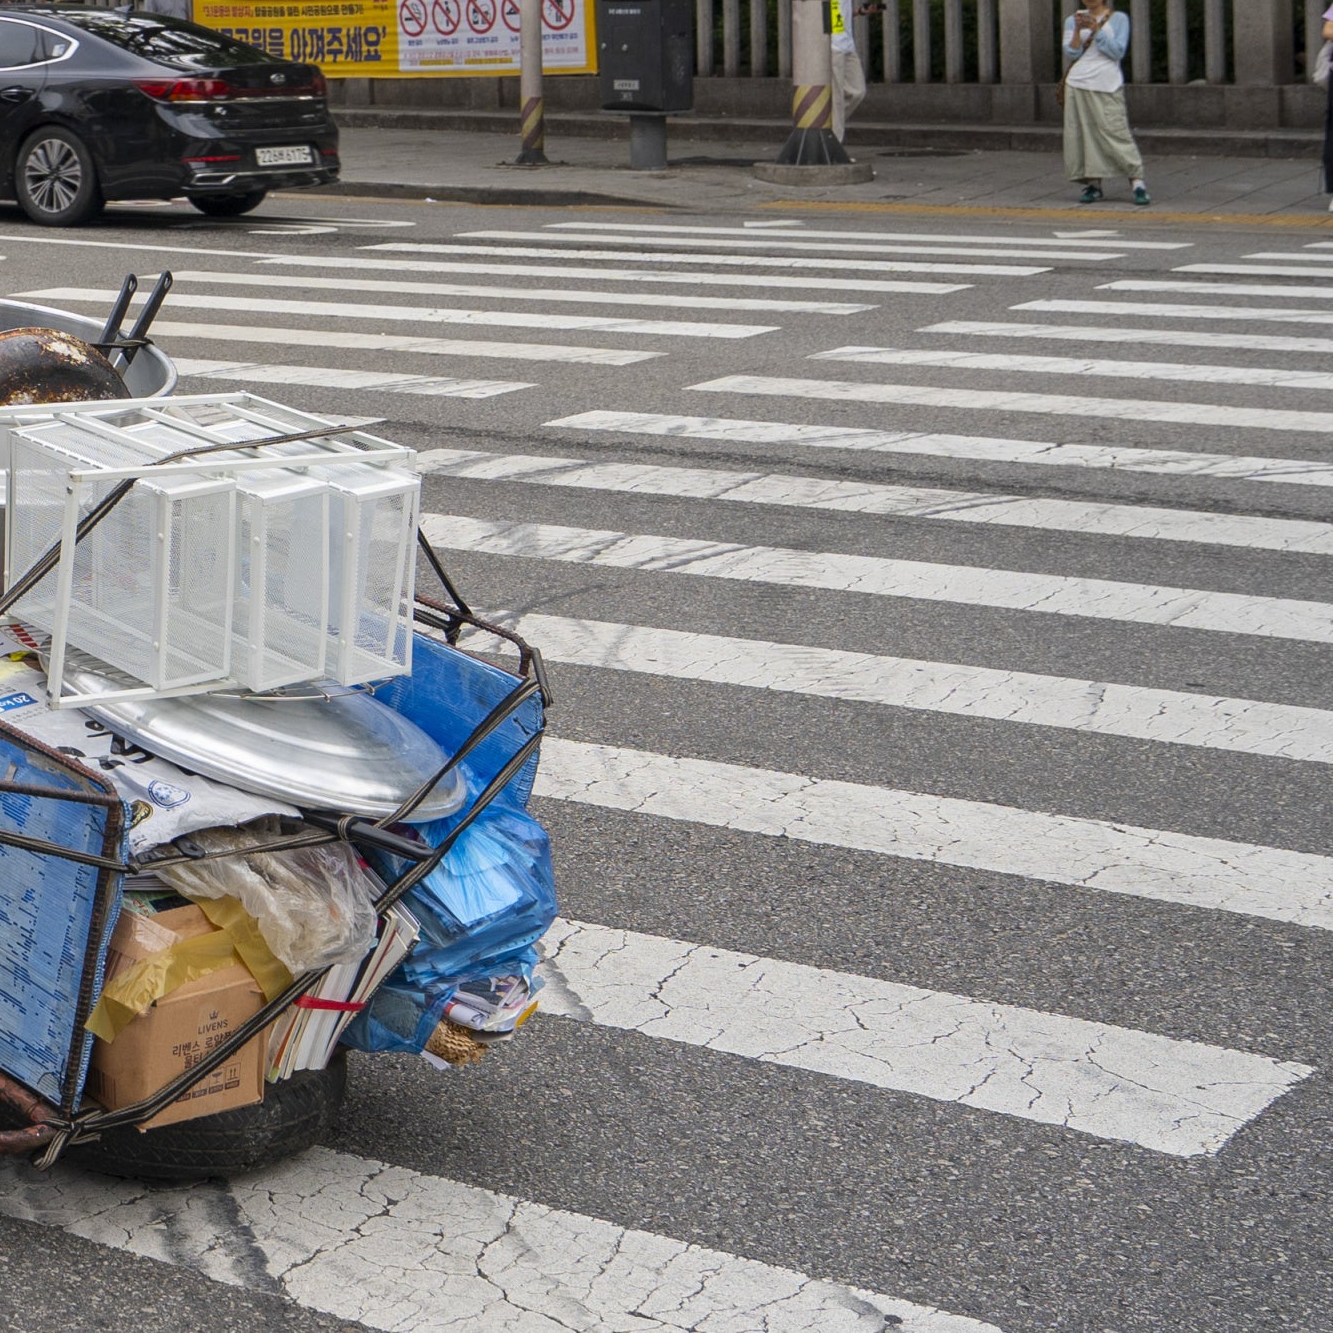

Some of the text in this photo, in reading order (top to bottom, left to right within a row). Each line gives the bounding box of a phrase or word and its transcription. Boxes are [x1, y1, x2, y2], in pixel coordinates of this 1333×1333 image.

[300, 4, 340, 17] 시민공원으로
[197, 1019, 229, 1035] LIVENS
[172, 1042, 201, 1057] 리벤스
